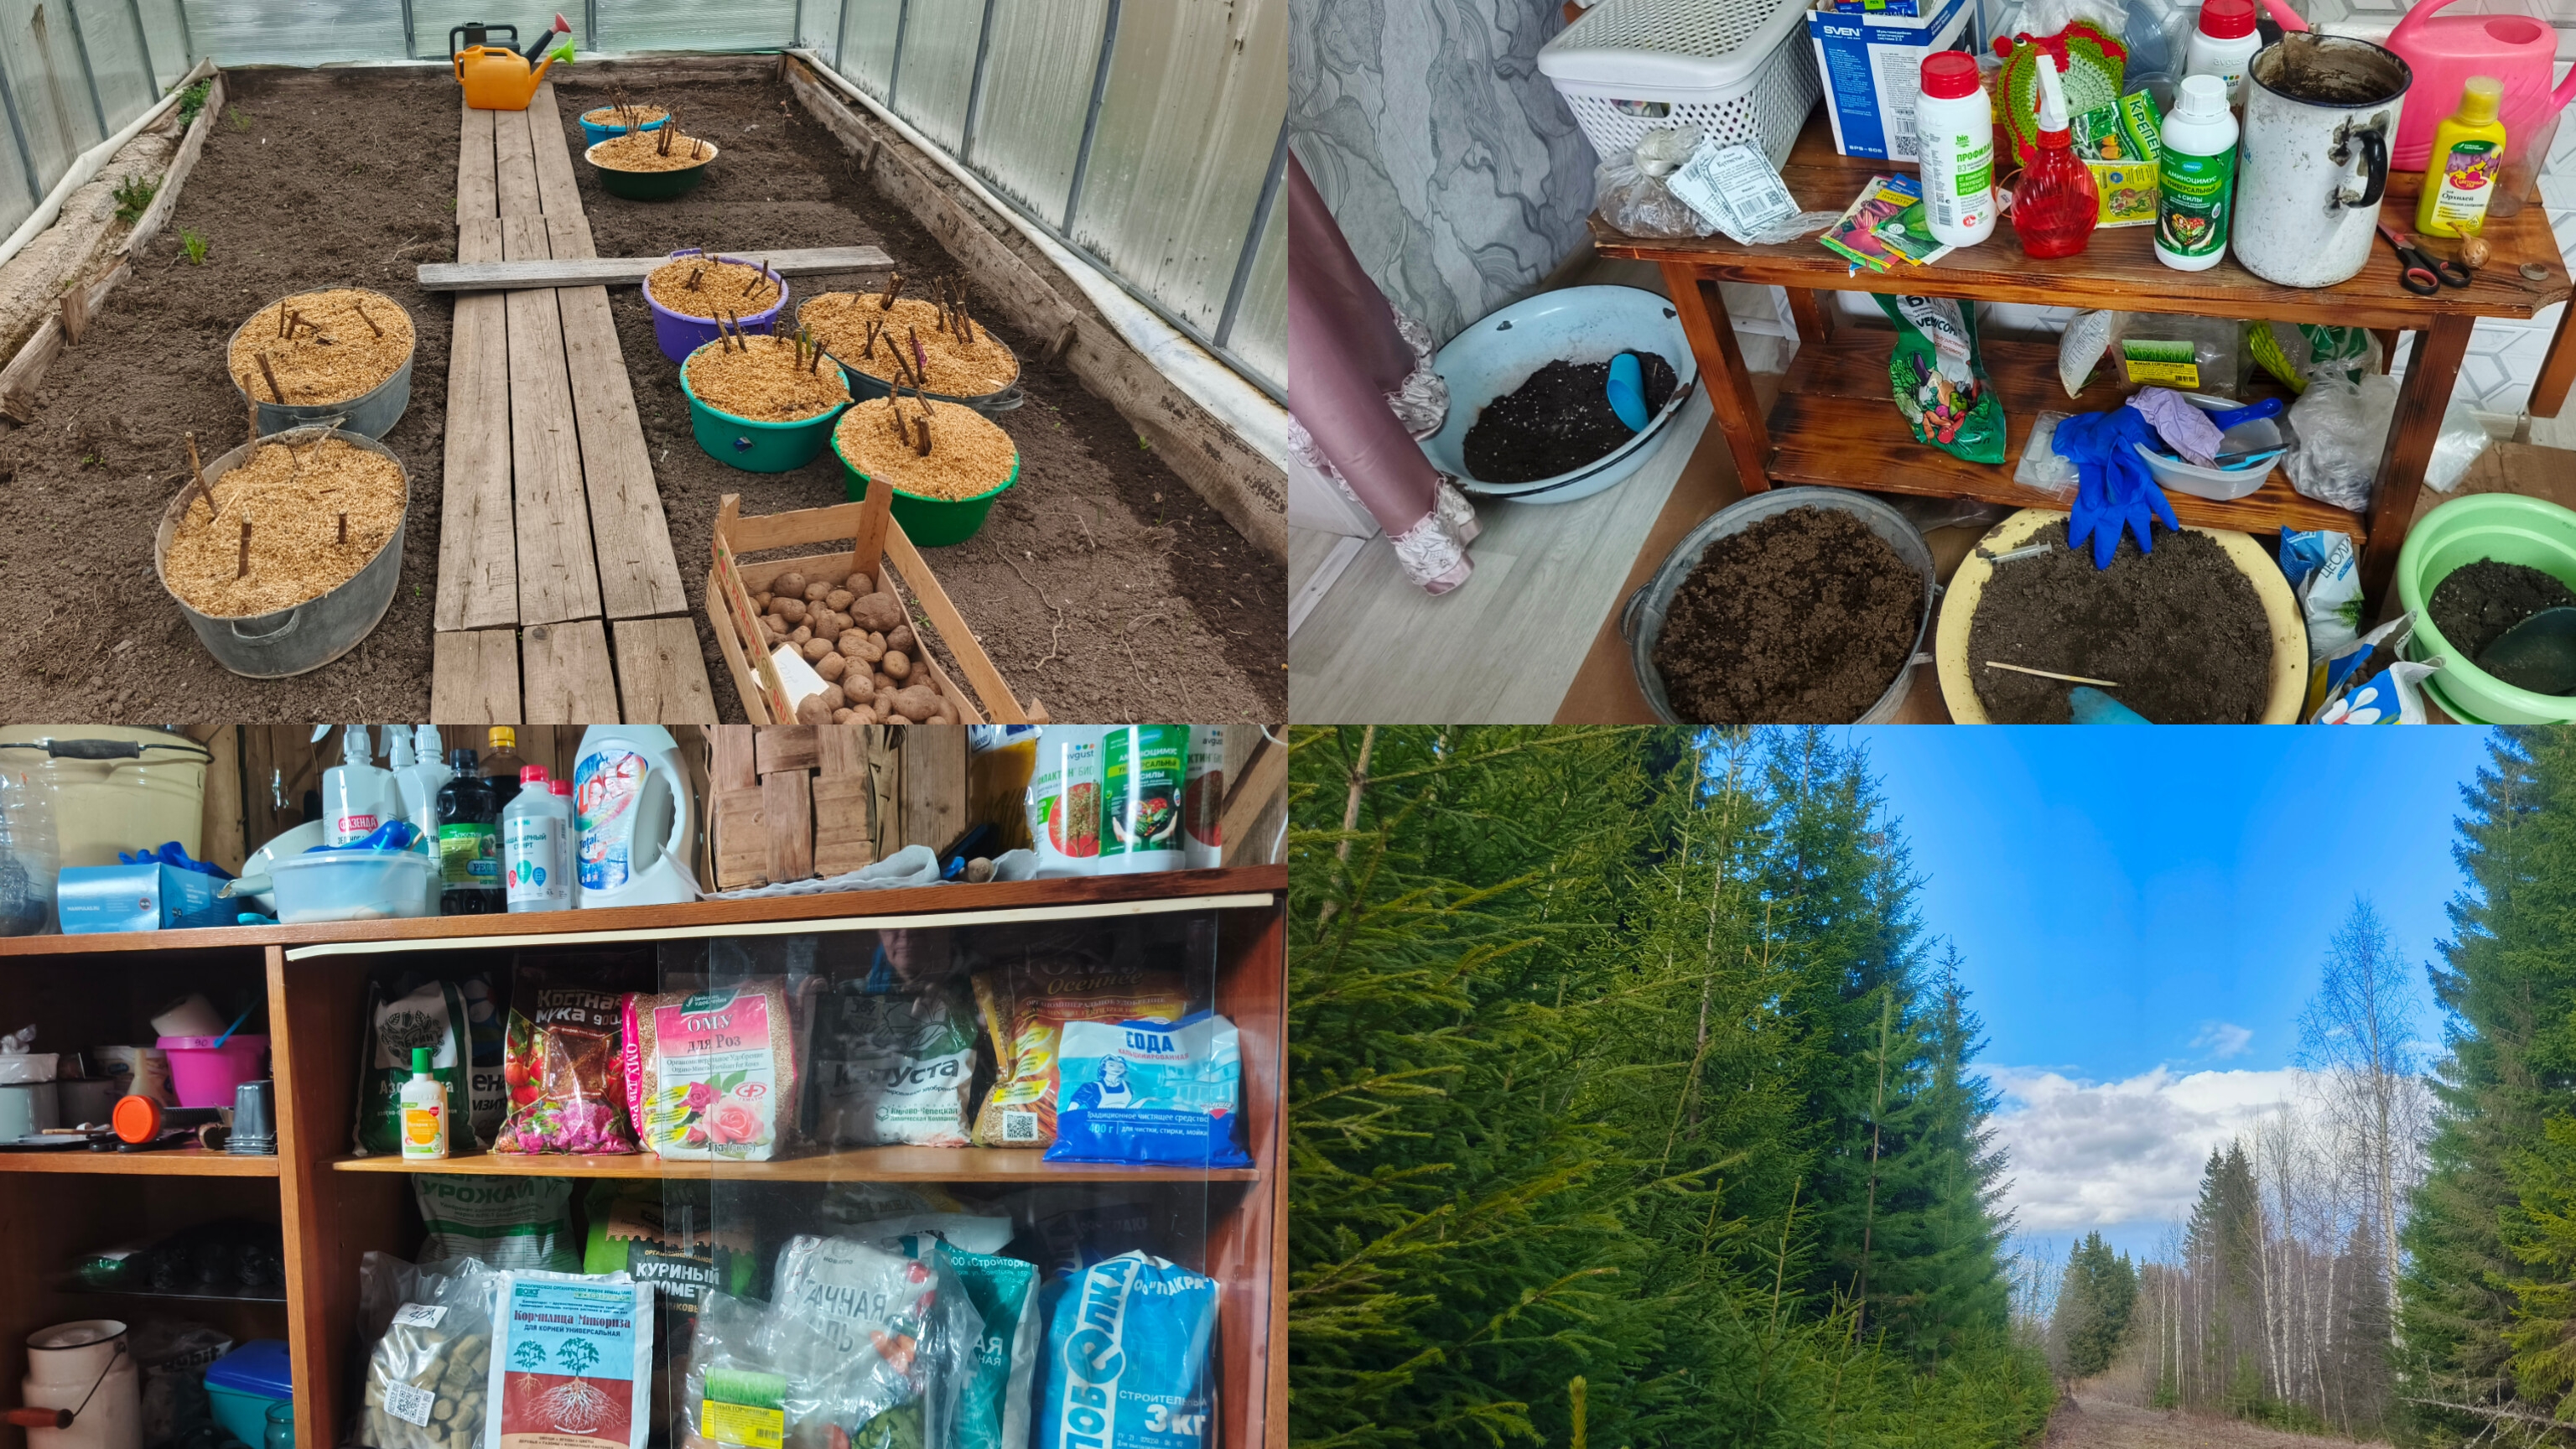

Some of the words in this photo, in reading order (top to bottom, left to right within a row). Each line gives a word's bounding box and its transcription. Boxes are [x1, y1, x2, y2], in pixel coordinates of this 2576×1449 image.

[1823, 25, 1861, 36] SVEN
[2168, 170, 2217, 184] АМИНОЦИМУС
[1141, 771, 1166, 780] СИЛЫ
[579, 834, 598, 851] Total
[1047, 973, 1144, 995] Осеннее
[536, 1007, 586, 1023] мука
[688, 1014, 733, 1032] ОМУ
[687, 1039, 711, 1054] для
[715, 1034, 741, 1048] Роз
[1125, 1031, 1175, 1054] СОДА
[626, 1043, 640, 1076] ОМУ
[1118, 1048, 1189, 1060] КАЛЬЦИНИРОВАННАЯ
[1087, 1110, 1138, 1120] Традиционное
[1138, 1113, 1174, 1122] чистящее
[636, 1261, 720, 1285] КУРИНЫЙ
[654, 1280, 708, 1298] ПОМЕТ
[514, 1310, 574, 1325] Кормилица
[578, 1314, 631, 1329] Микориза
[538, 1325, 564, 1333] КОРНЕЙ
[565, 1327, 621, 1337] УНИВЕРСАЛЬНАЯ
[1144, 1403, 1168, 1433] 3
